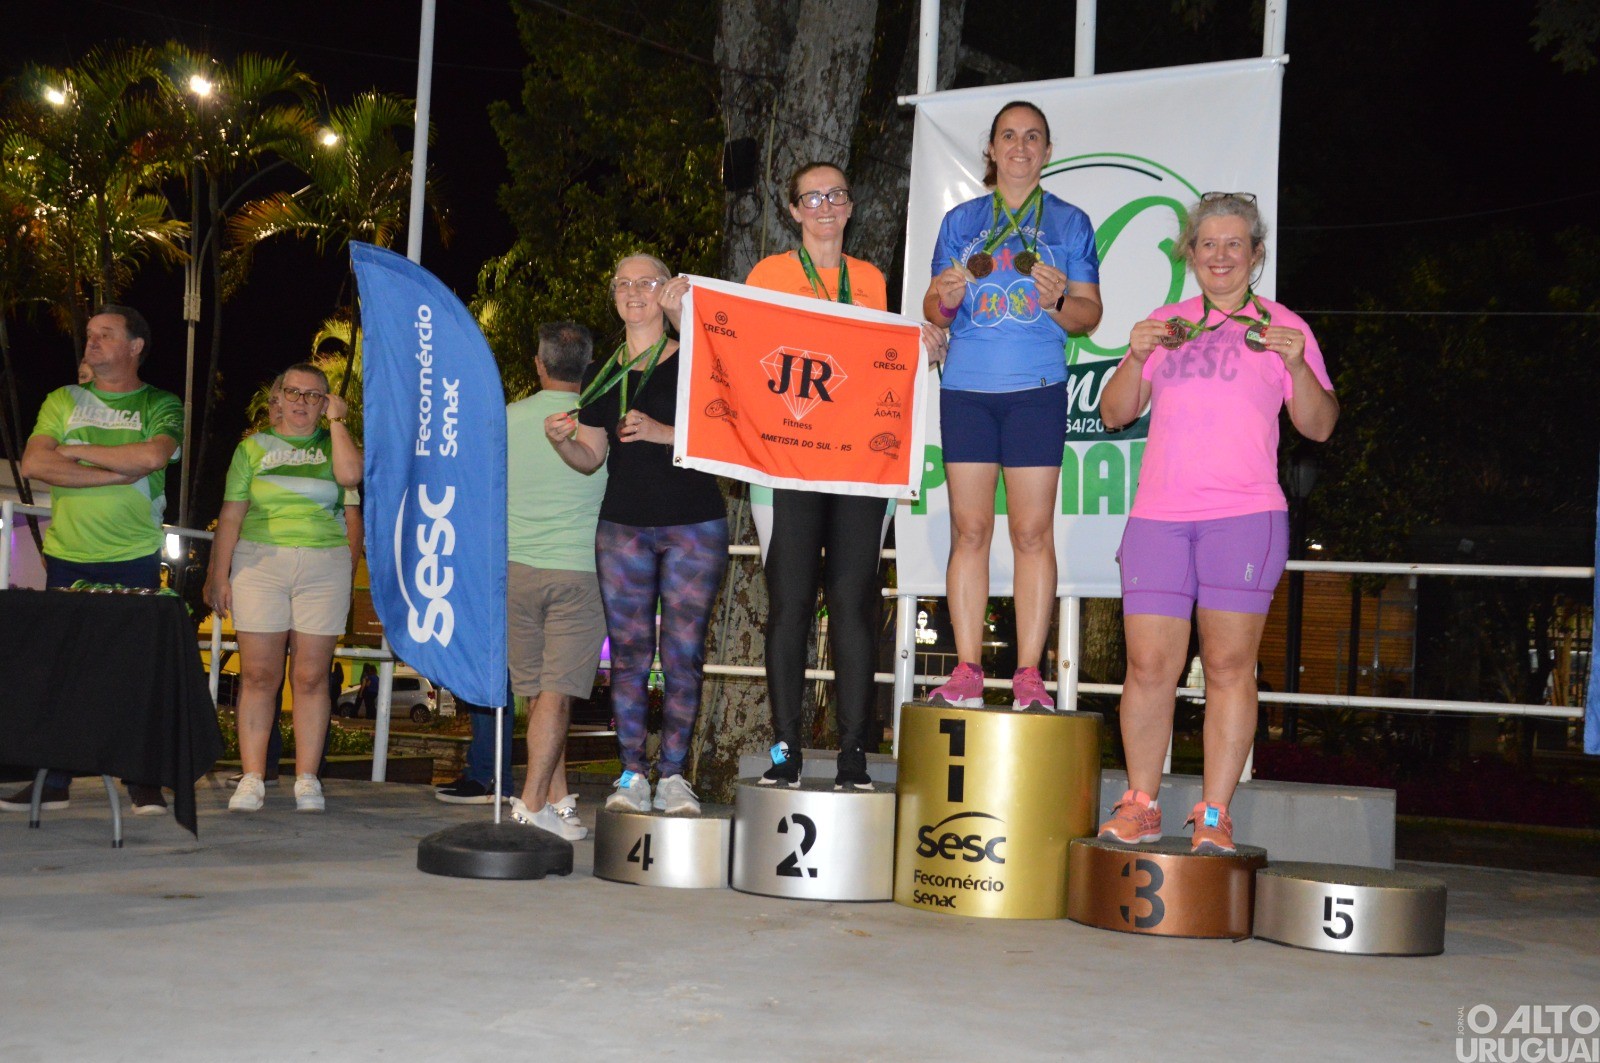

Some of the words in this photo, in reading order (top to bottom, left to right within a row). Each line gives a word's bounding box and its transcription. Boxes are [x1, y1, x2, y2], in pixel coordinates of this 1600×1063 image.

[703, 323, 738, 339] CRESOL
[414, 304, 433, 456] Fecomércio
[767, 352, 834, 403] JR
[873, 360, 908, 371] CRESOL
[1162, 345, 1241, 382] SESC
[439, 377, 460, 458] Senac
[783, 417, 813, 430] Fitness
[874, 408, 901, 419] ÁGATA
[760, 432, 799, 446] AMETISTA
[801, 439, 814, 449] DO
[816, 441, 832, 451] SUL
[840, 443, 852, 452] RS
[939, 718, 966, 803] 1
[626, 833, 655, 872] 4
[775, 812, 818, 879] 2
[913, 869, 1005, 892] Fecomércio
[913, 889, 957, 909] Senac
[1119, 858, 1165, 929] 3
[1322, 896, 1354, 940] 5
